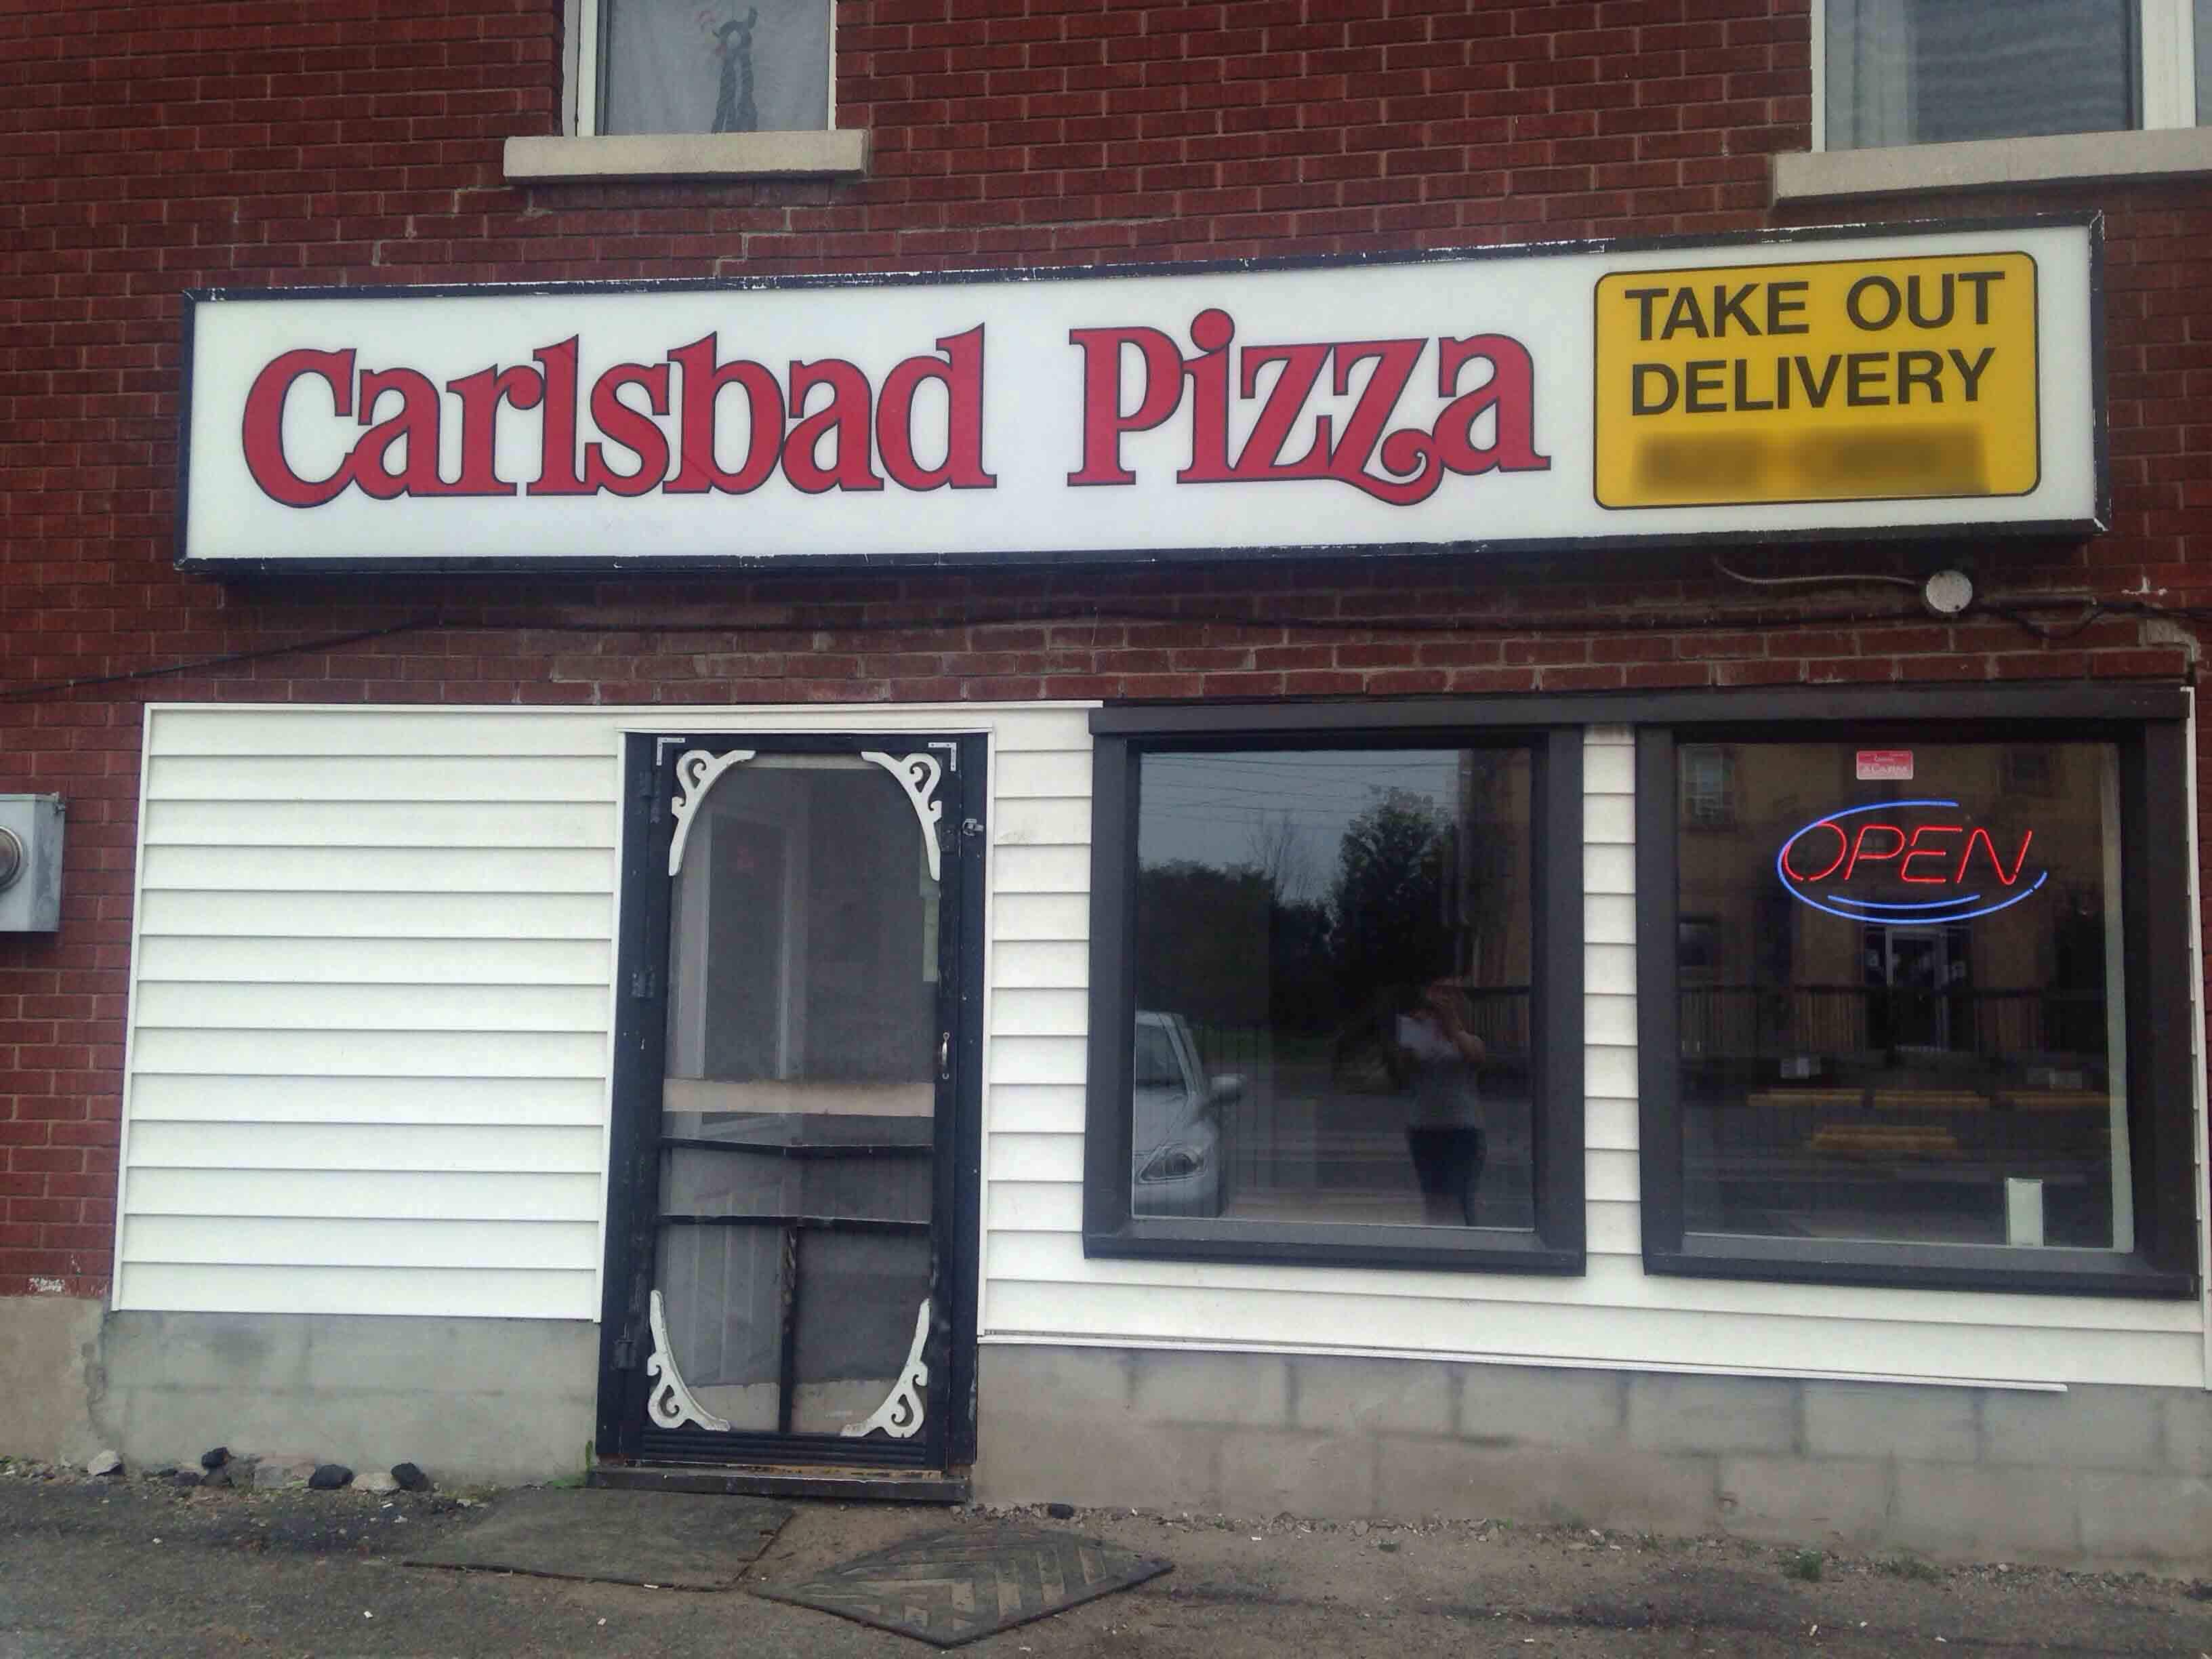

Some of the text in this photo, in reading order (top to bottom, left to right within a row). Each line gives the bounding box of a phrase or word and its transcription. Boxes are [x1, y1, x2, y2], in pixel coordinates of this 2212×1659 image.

[1624, 271, 2006, 342] TAKE OUT
[241, 308, 1552, 508] Carlsbad Pizza
[1631, 347, 1996, 416] DELIVERY
[1783, 822, 2033, 886] OPEN
